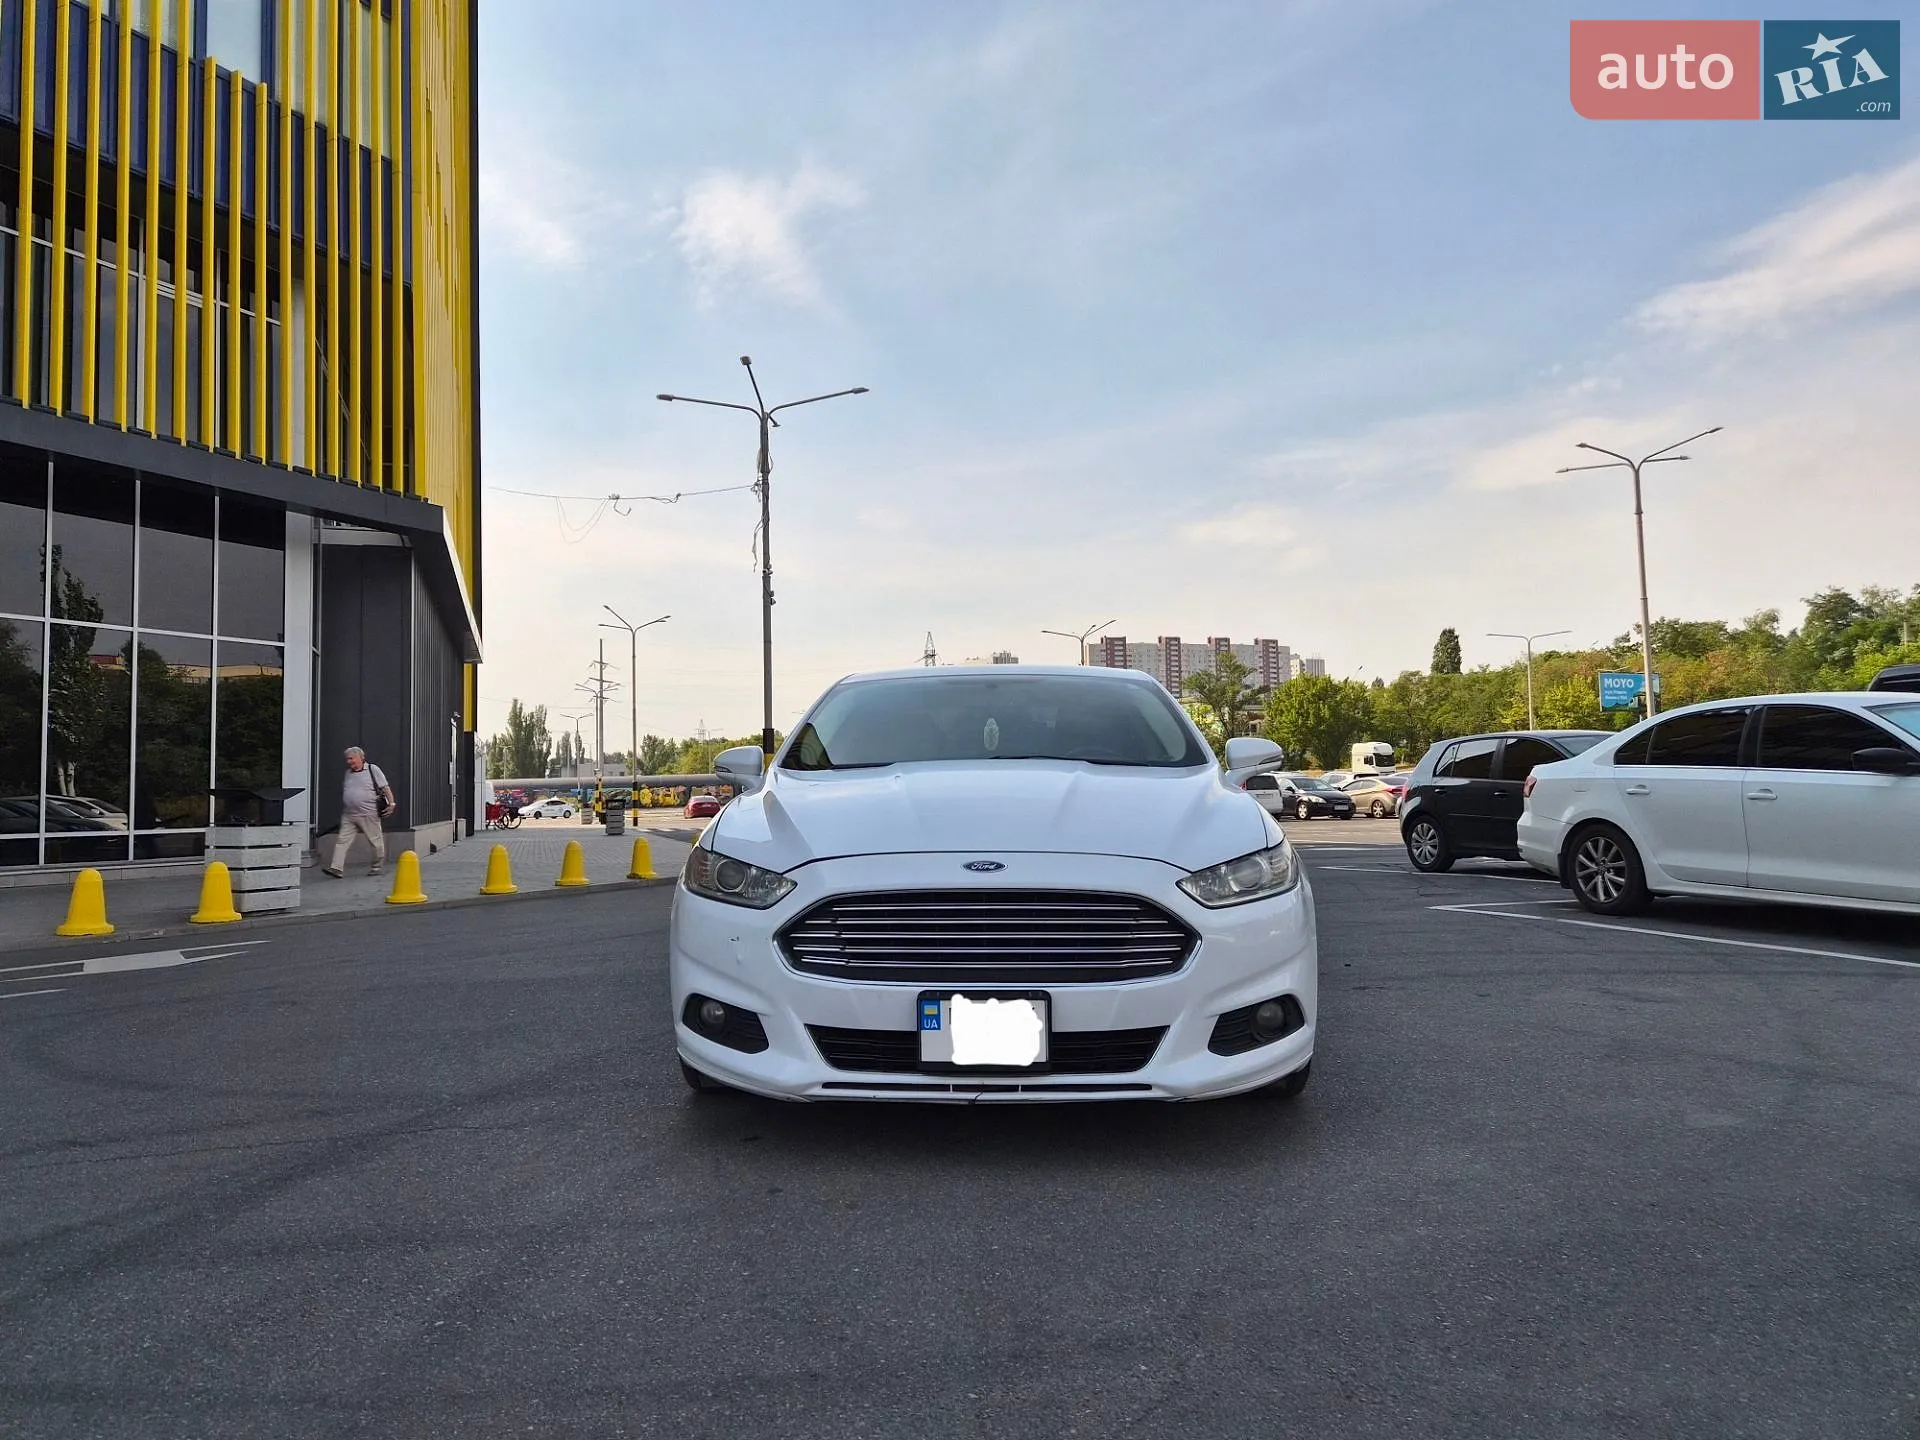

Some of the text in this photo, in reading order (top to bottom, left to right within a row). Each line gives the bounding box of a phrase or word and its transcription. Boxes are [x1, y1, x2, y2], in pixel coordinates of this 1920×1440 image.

[1604, 678, 1634, 688] MOYO
[971, 862, 997, 870] Ford
[924, 1019, 938, 1029] UA
